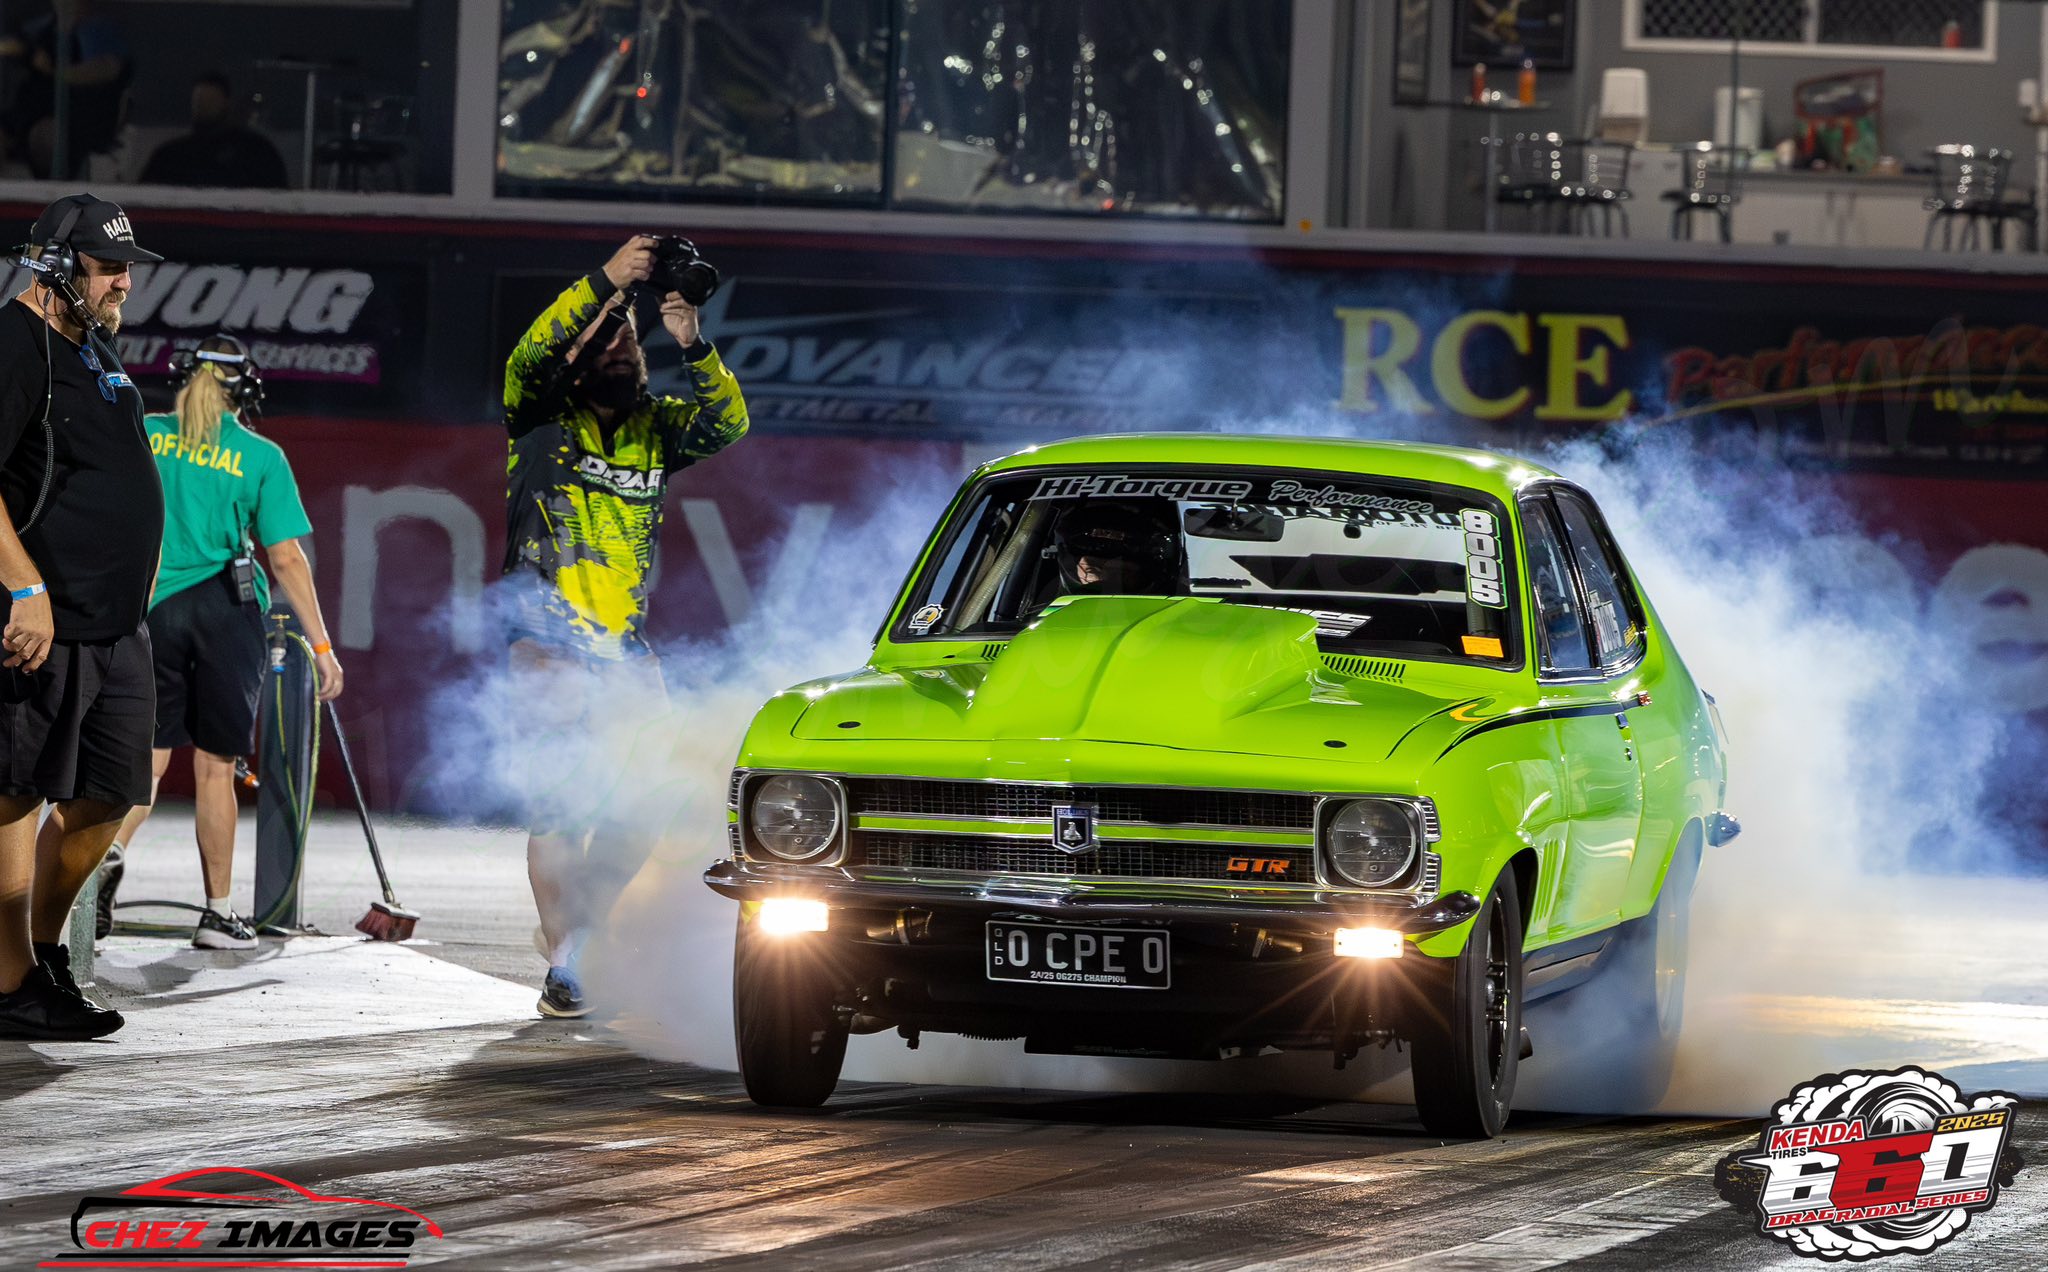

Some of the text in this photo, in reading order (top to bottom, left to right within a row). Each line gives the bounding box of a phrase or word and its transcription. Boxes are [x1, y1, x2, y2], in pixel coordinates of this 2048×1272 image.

[1333, 305, 1634, 421] RCE
[1029, 475, 1434, 514] Hi-Torque Performance
[1459, 508, 1508, 609] 8005
[1226, 857, 1291, 873] GTR
[994, 928, 1004, 966] QLD
[1046, 932, 1126, 973] CPE
[1084, 974, 1127, 984] CHAMPION
